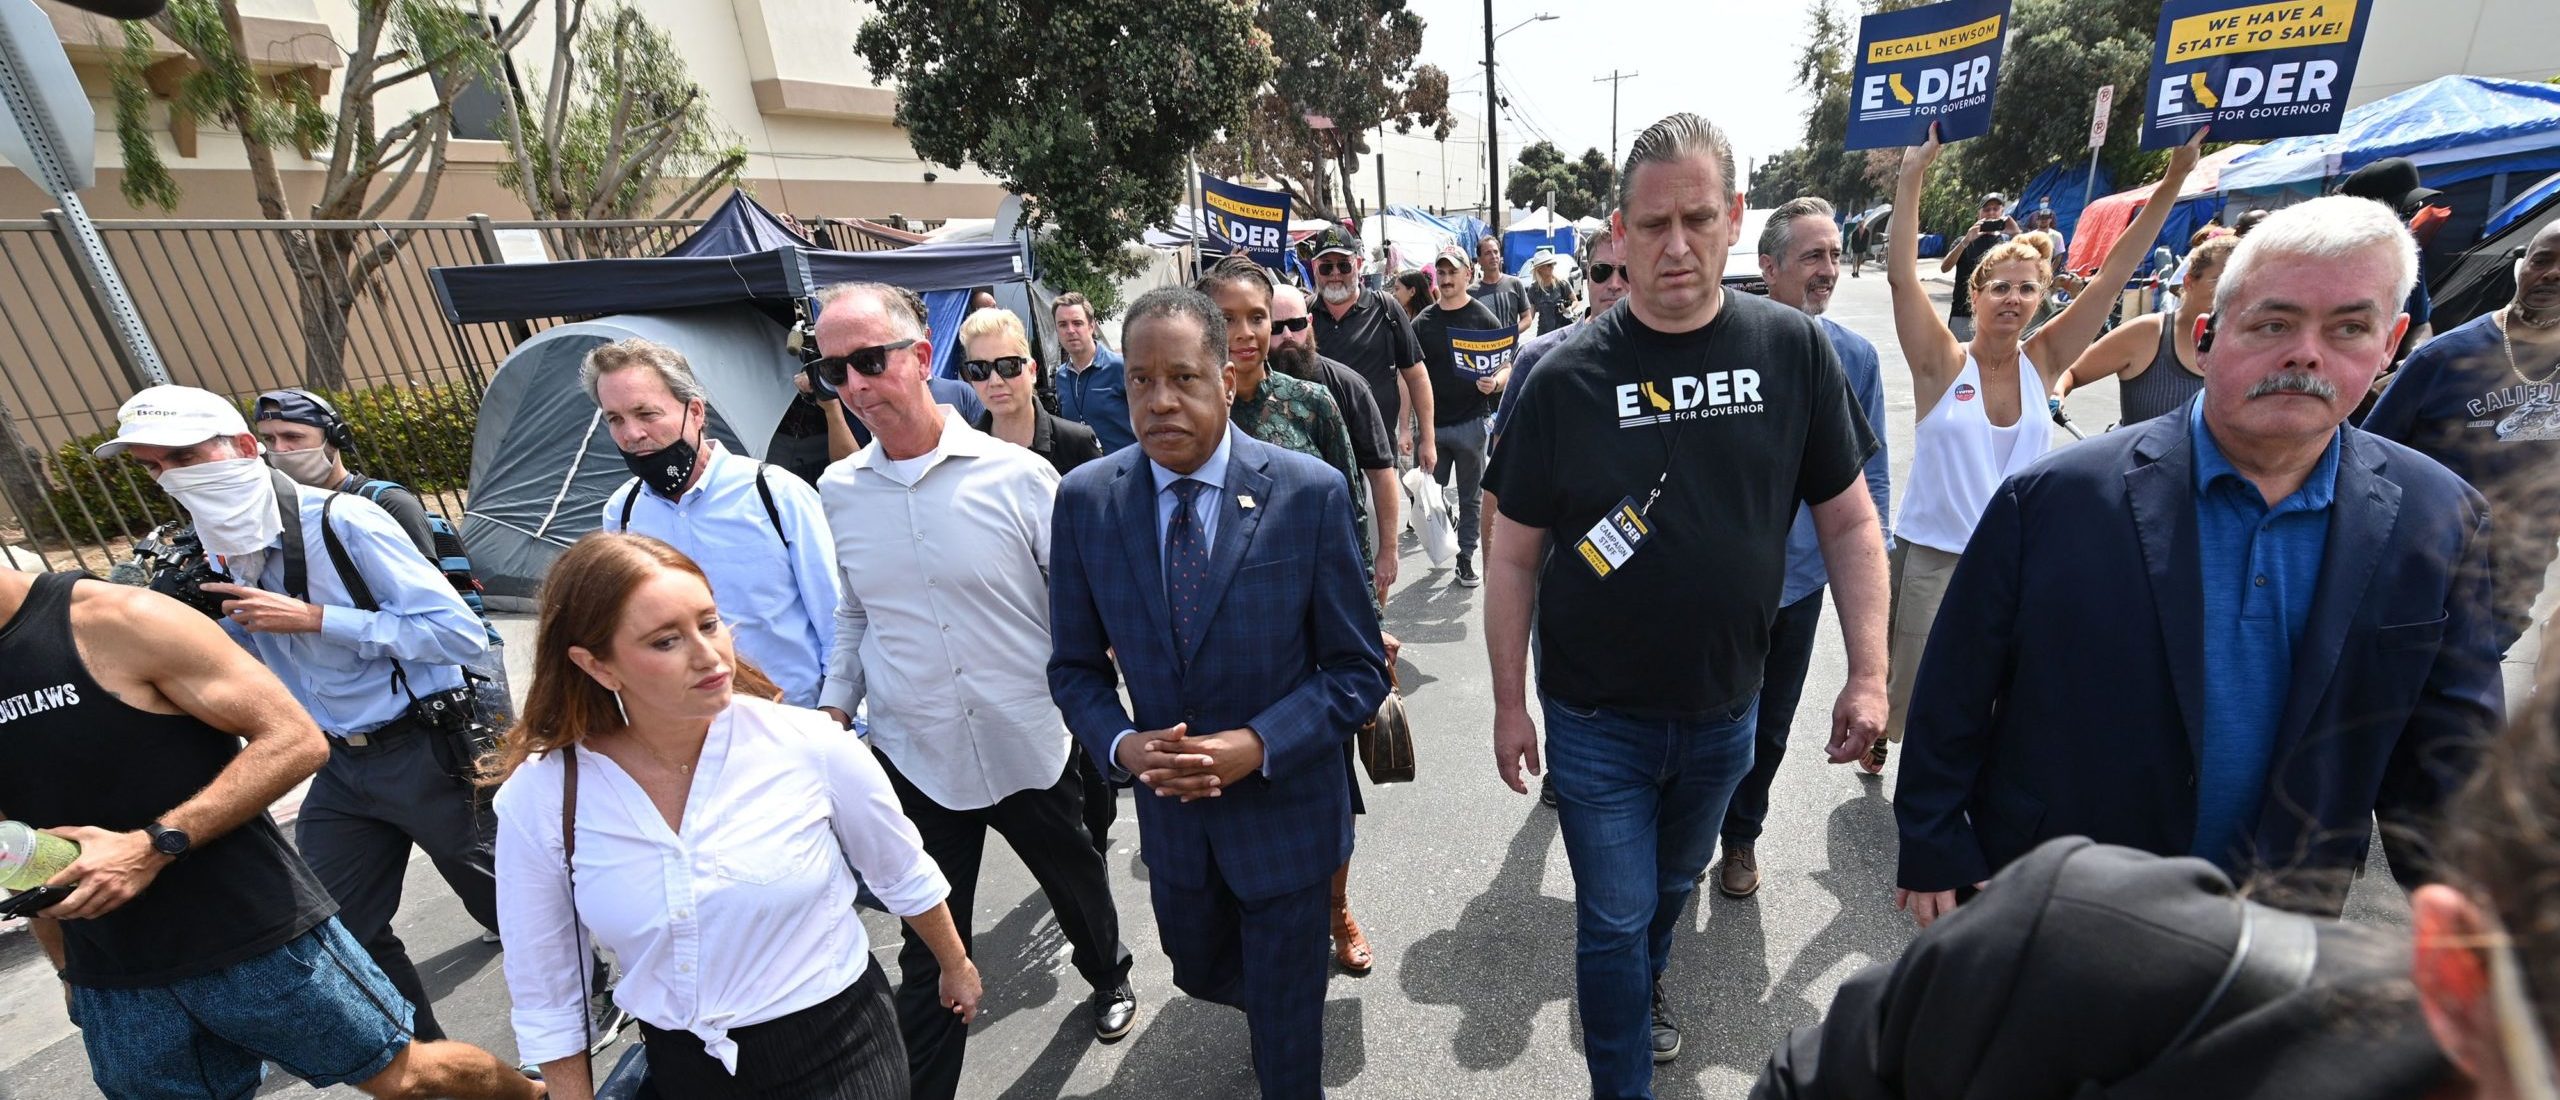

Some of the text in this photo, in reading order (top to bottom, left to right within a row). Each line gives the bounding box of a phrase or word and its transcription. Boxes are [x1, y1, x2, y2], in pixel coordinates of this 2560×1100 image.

[2209, 5, 2324, 32] WE HAVE A
[1875, 23, 1996, 57] RECALL NEWSOM
[2176, 21, 2343, 54] STATE TO SAVE!
[1915, 94, 1986, 116] FOR GOVERNOR
[2217, 103, 2331, 121] FOR GOVERNOR
[1208, 195, 1279, 218] RECALL NEWSOM
[1674, 404, 1765, 421] FOR GOVERNOR
[1599, 536, 1617, 556] STAFF
[1600, 524, 1628, 557] CAMPAIGN
